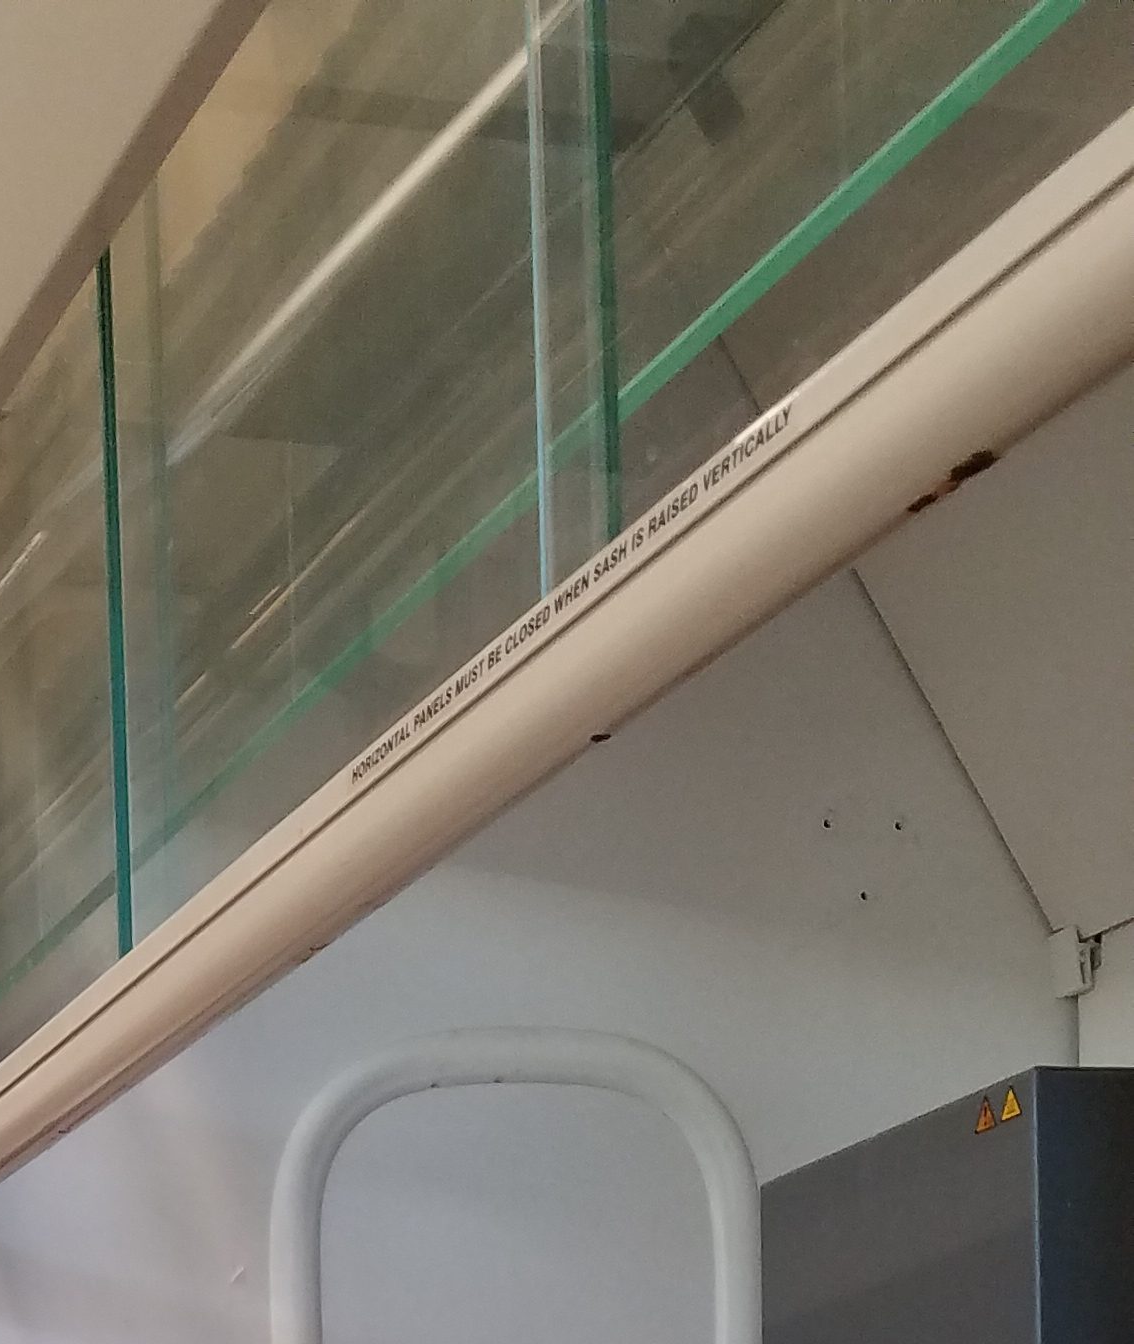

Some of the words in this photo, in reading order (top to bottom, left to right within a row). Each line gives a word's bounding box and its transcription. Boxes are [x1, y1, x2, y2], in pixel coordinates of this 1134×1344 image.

[352, 723, 411, 784] HORIZONTAL
[414, 687, 452, 732] PANELS
[454, 659, 485, 698] MUST
[487, 644, 502, 670] BE
[505, 604, 551, 655] CLOSED
[554, 570, 590, 614] WHEN
[593, 540, 627, 582] SASH
[632, 527, 644, 551] IS
[648, 483, 699, 539] RAISED
[703, 402, 793, 491] VERTICALLY
